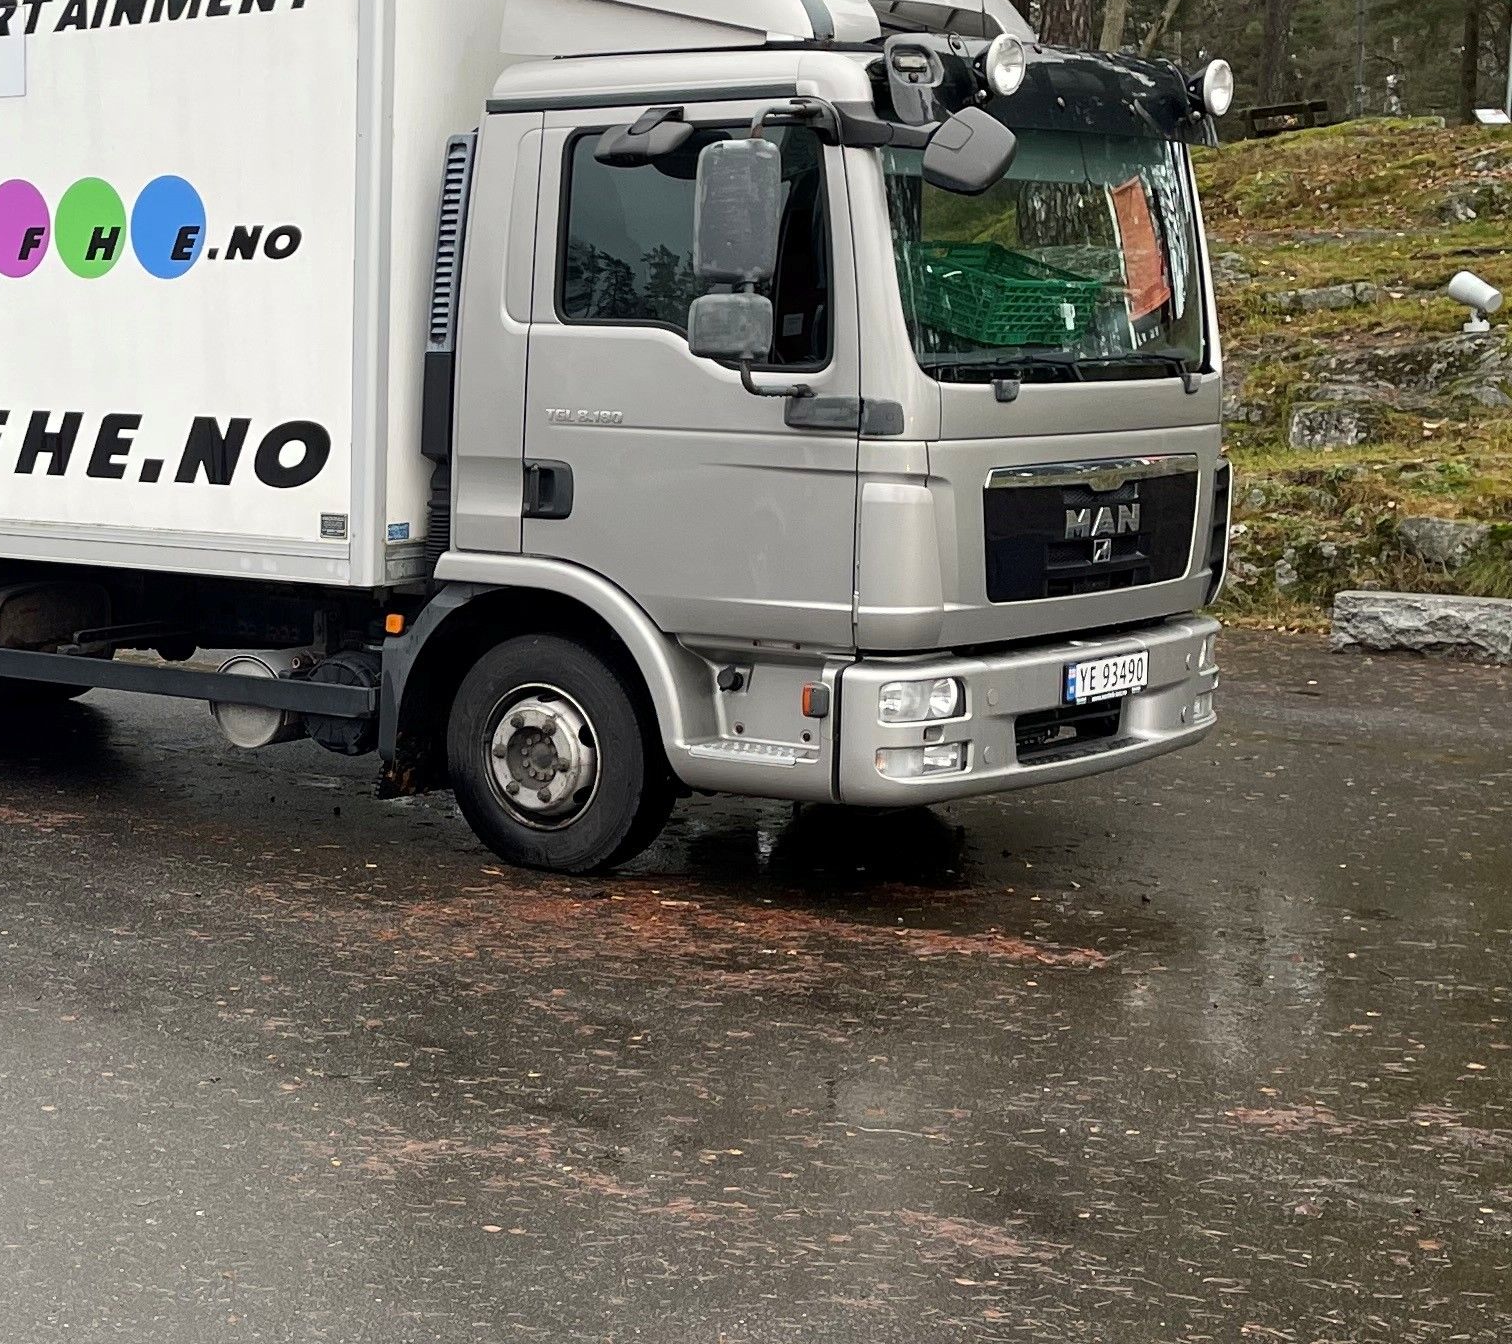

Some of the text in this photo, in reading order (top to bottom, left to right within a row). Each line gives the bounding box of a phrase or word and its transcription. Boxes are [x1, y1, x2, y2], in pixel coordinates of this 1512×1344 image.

[1065, 504, 1141, 540] MAN
[1080, 657, 1144, 692] YE 93490
